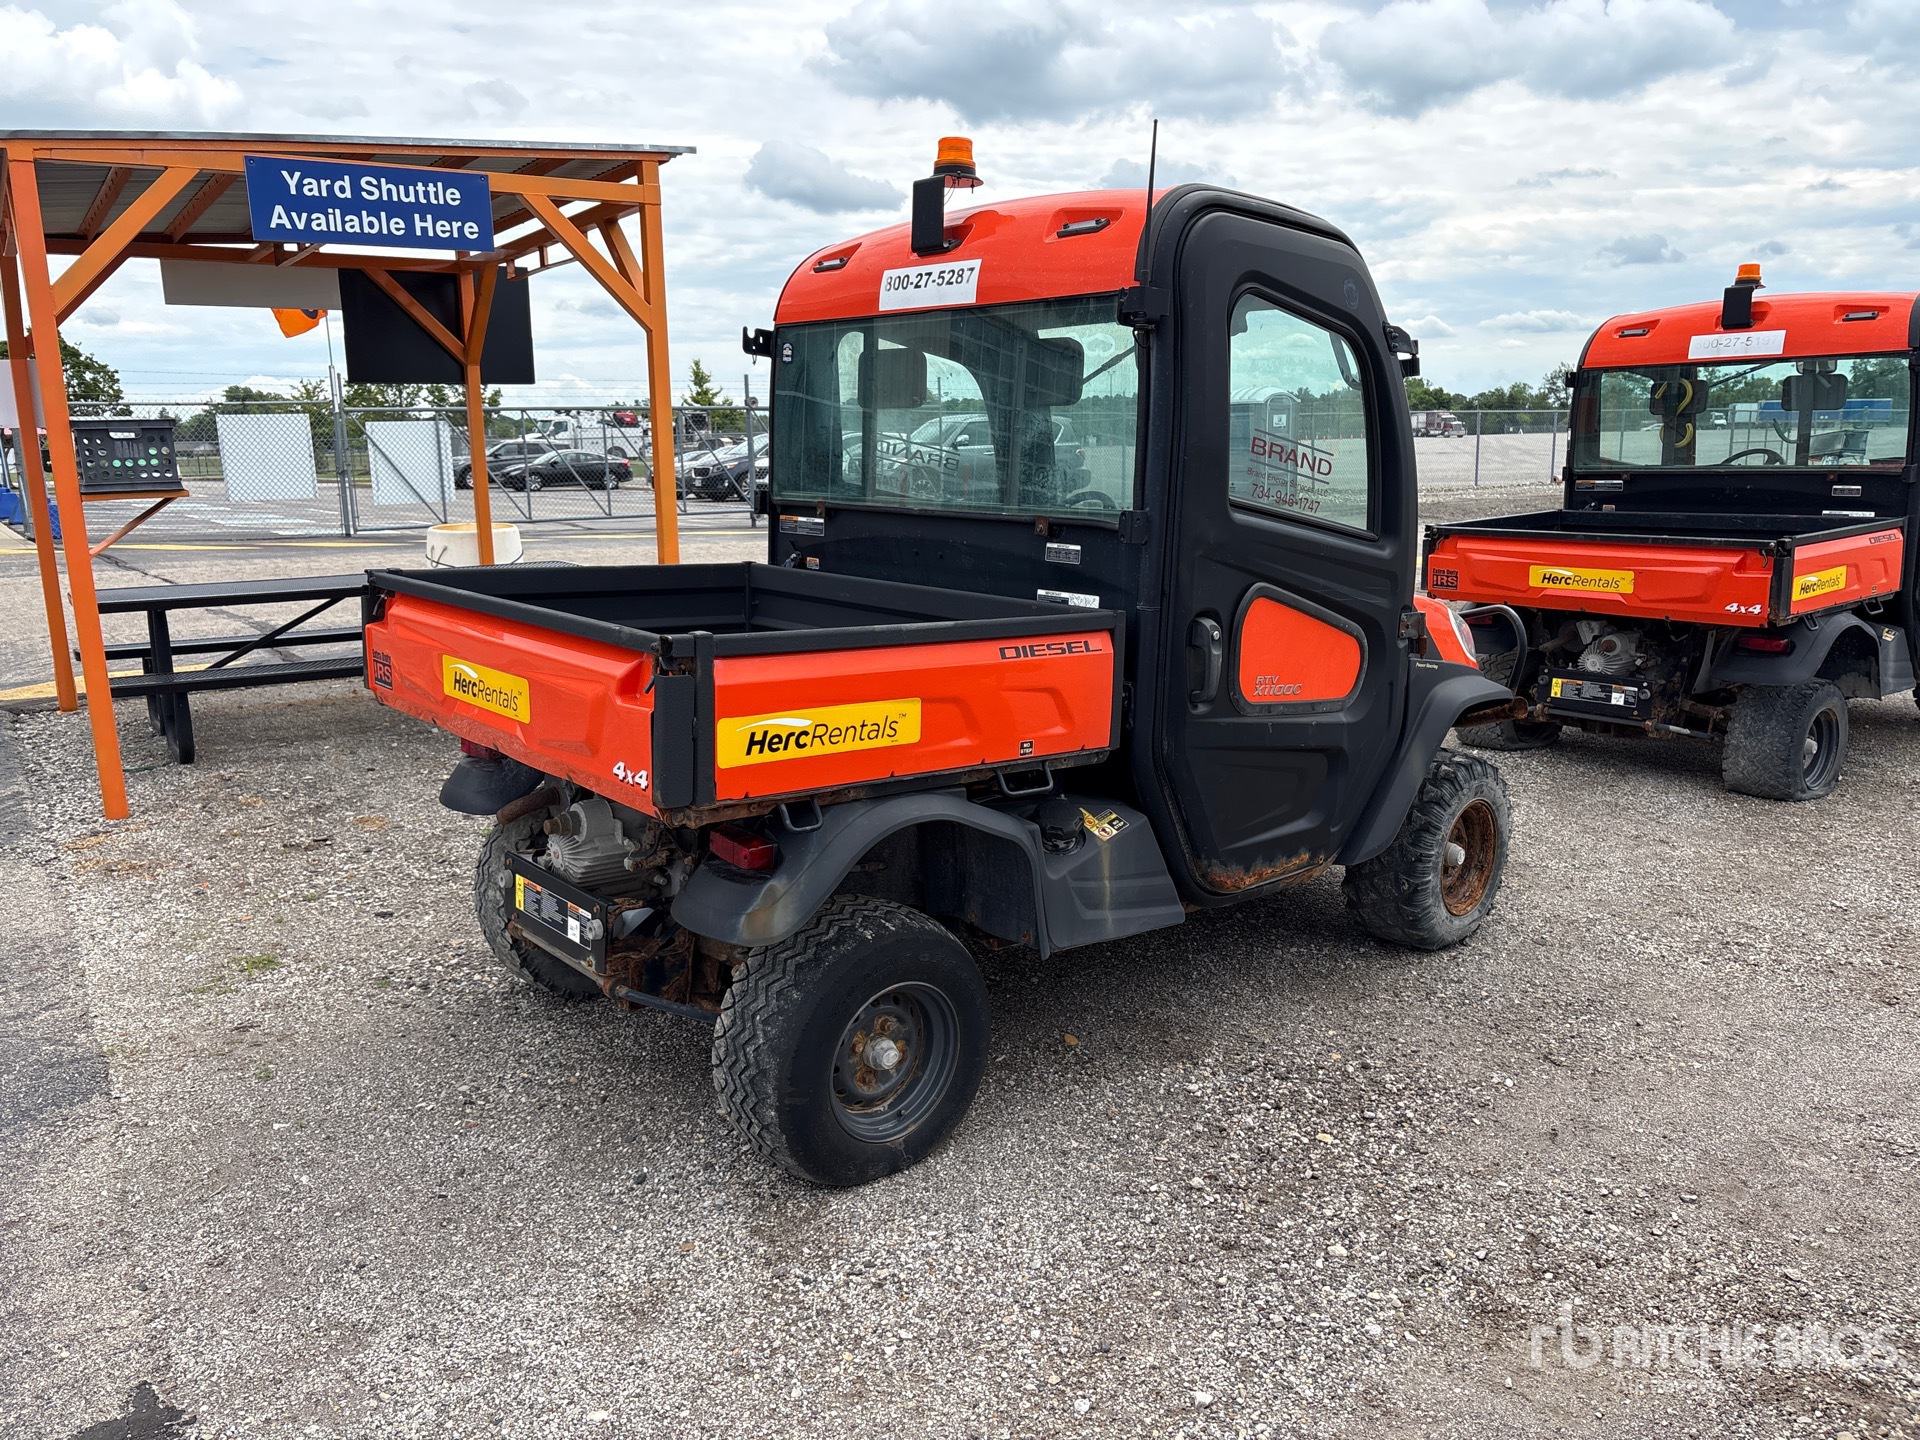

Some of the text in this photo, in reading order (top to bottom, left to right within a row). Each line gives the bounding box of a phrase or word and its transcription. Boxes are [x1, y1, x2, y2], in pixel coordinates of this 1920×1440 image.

[281, 170, 462, 206] Yard Shuttle
[270, 205, 480, 240] Available Here
[885, 267, 976, 291] 800-27-5287
[1251, 436, 1332, 476] BRAND
[1247, 467, 1266, 479] Brand
[1251, 483, 1320, 514] 734-946-1747
[1869, 533, 1900, 545] DIESEL
[1433, 575, 1457, 586] IRS
[1725, 602, 1762, 615] 4x4
[999, 640, 1102, 660] DIESEL
[374, 660, 392, 683] IRS
[1256, 675, 1279, 684] RTV
[1253, 684, 1303, 696] X1100C
[612, 761, 649, 790] 4x4
